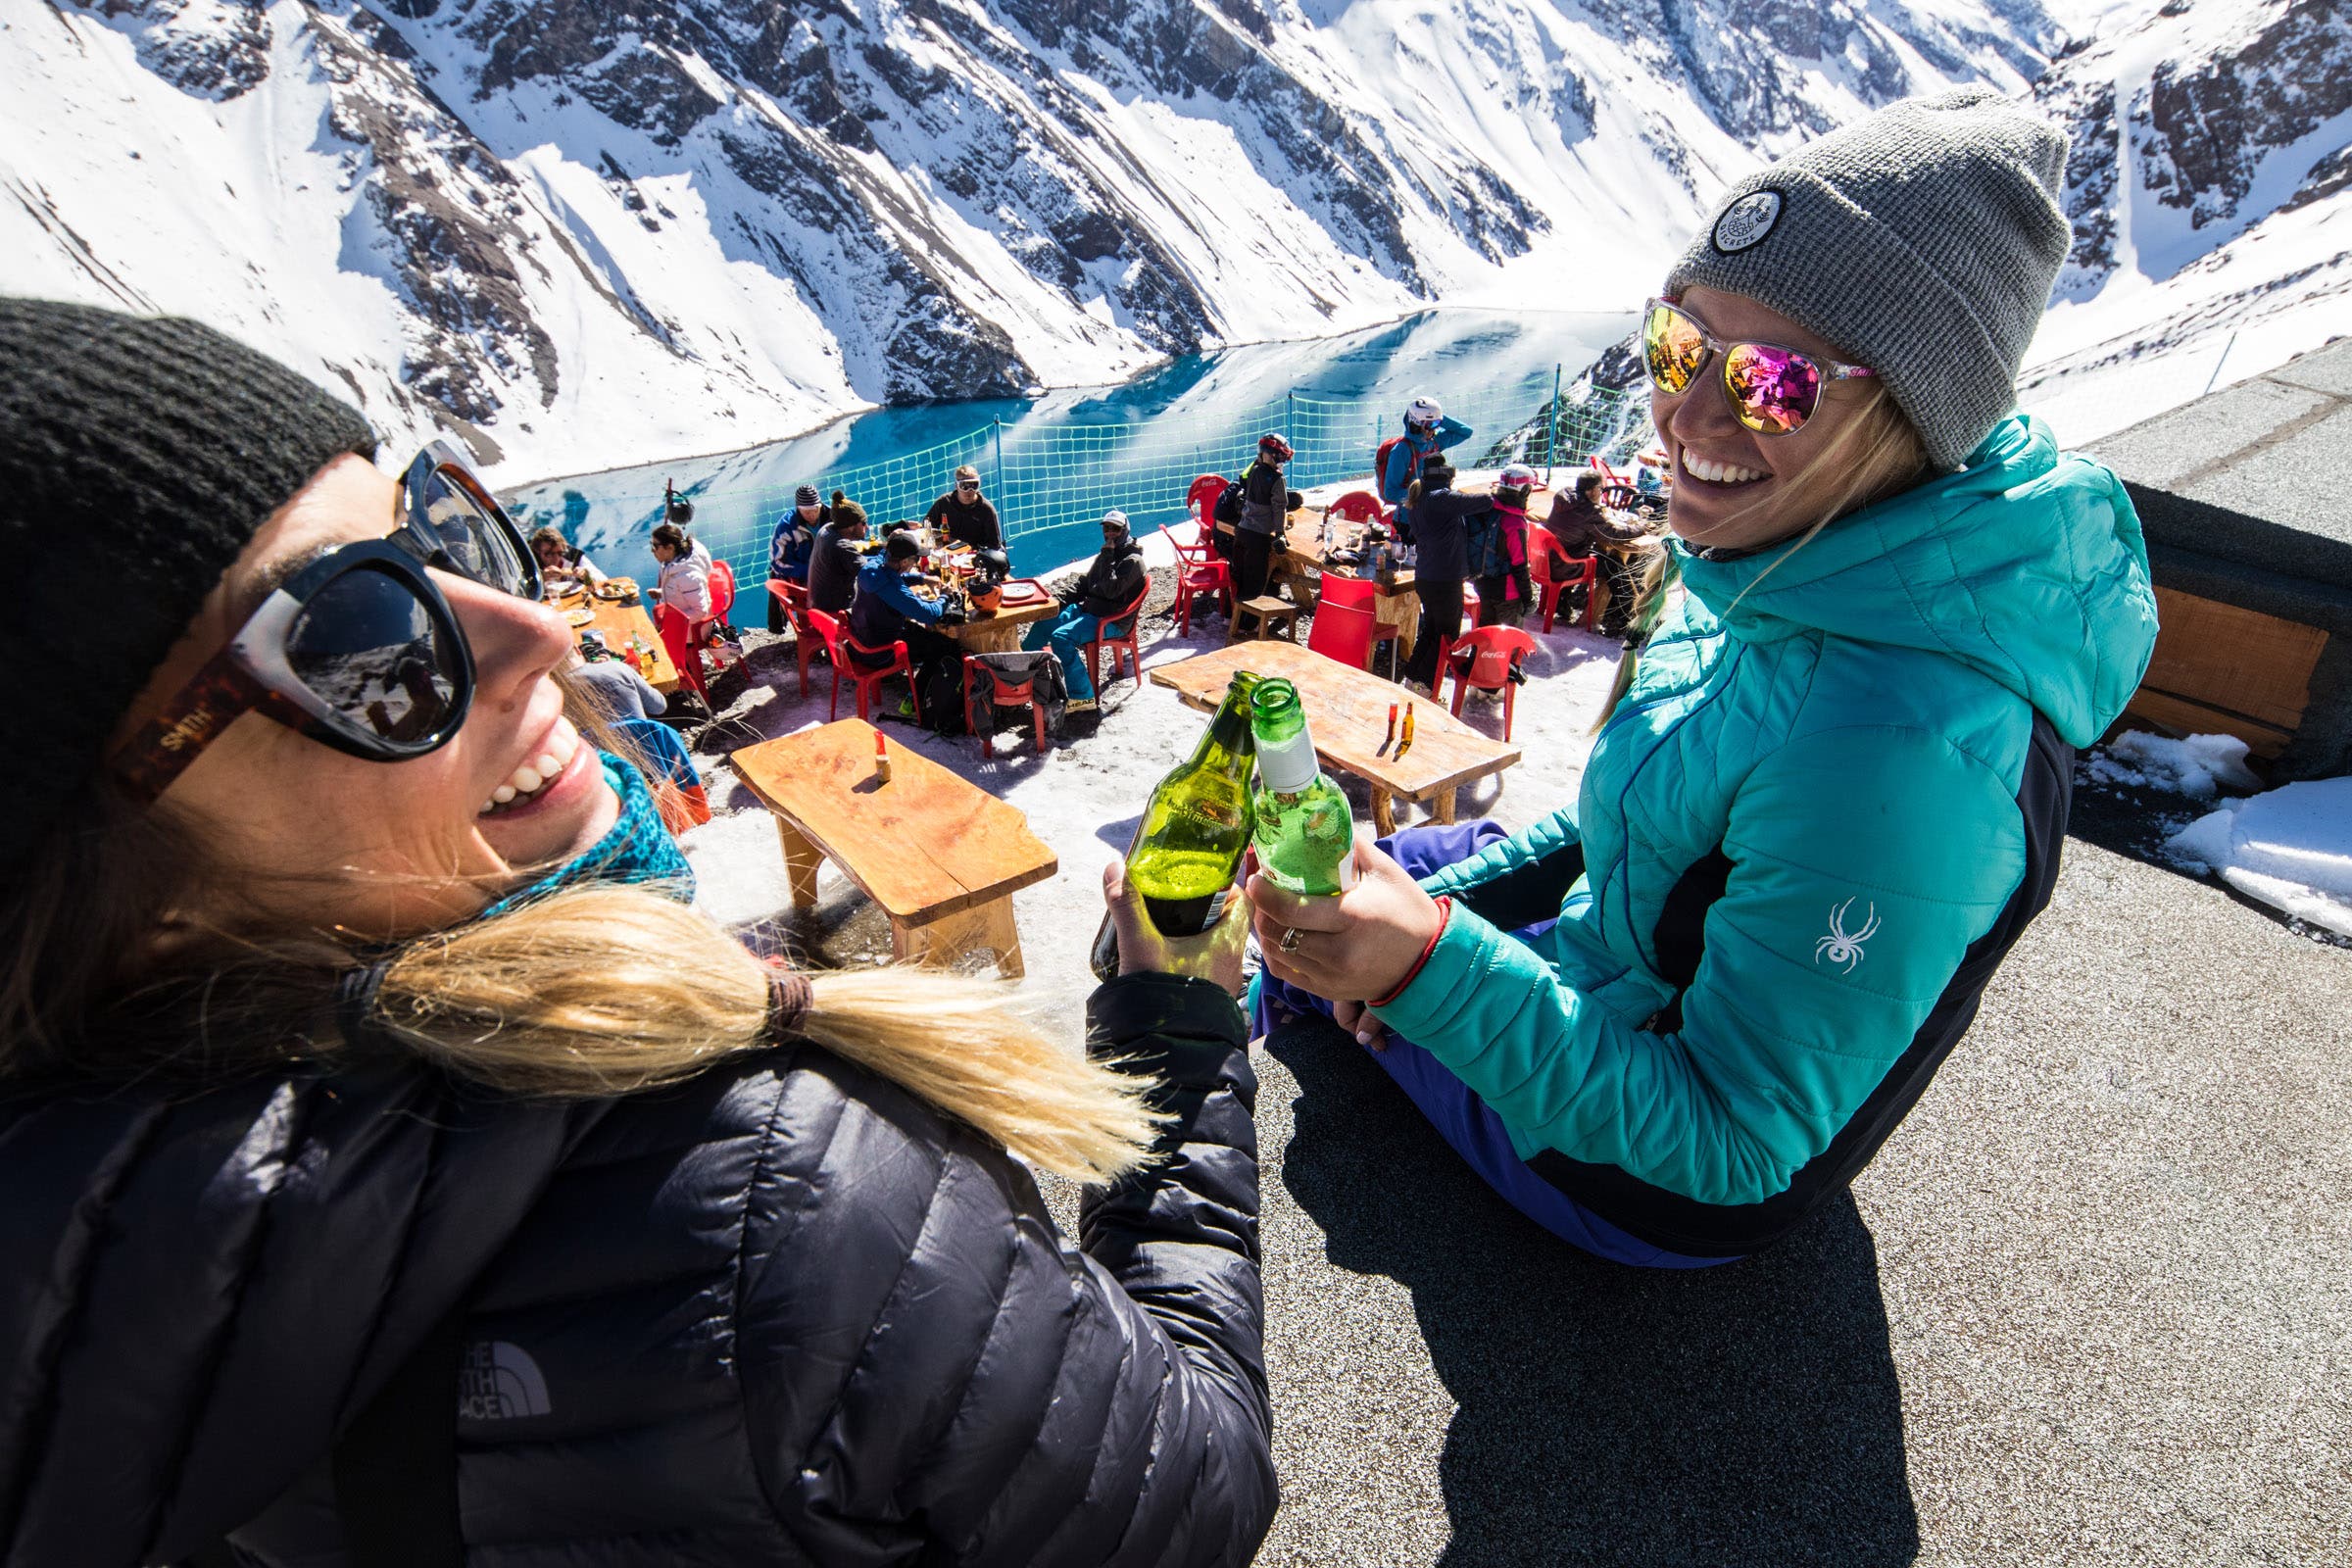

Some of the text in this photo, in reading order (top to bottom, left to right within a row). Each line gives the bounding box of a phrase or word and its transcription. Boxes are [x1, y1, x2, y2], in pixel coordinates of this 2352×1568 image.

[1719, 223, 1755, 246] DISCRETE
[1067, 698, 1096, 709] HEAD
[160, 707, 212, 752] SMITH
[459, 1394, 501, 1420] ACE
